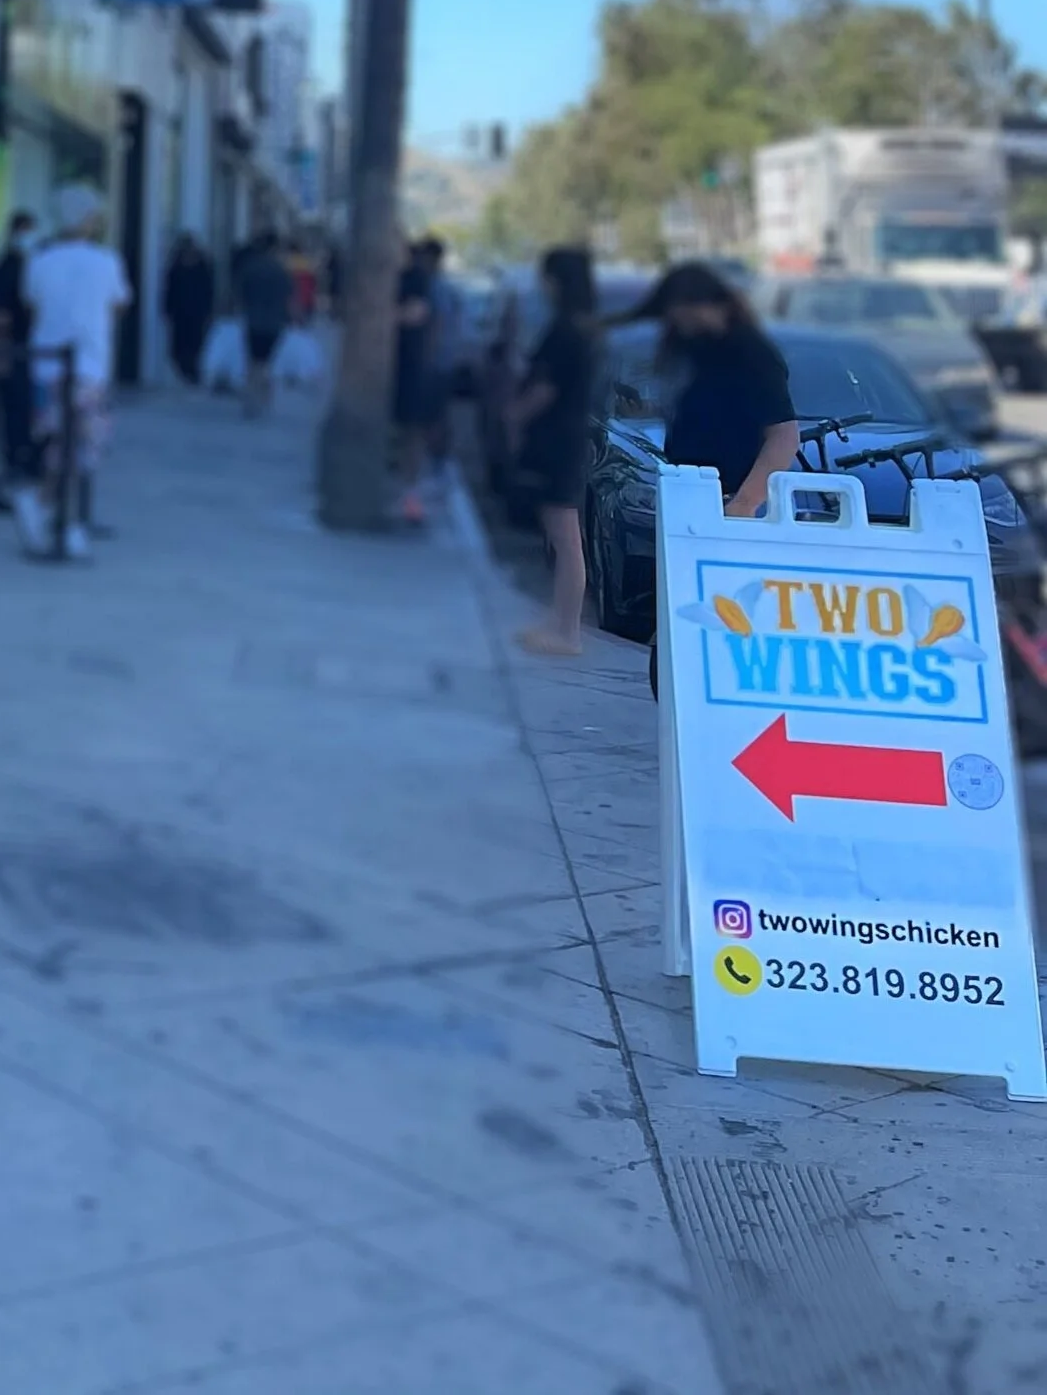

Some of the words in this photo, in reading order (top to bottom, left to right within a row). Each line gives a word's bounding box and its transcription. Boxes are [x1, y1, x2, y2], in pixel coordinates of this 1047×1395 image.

[763, 579, 904, 637] TWO
[725, 630, 956, 705] WINGS
[758, 908, 1000, 948] twowingschicken
[765, 957, 1006, 1006] 323.819.8952
